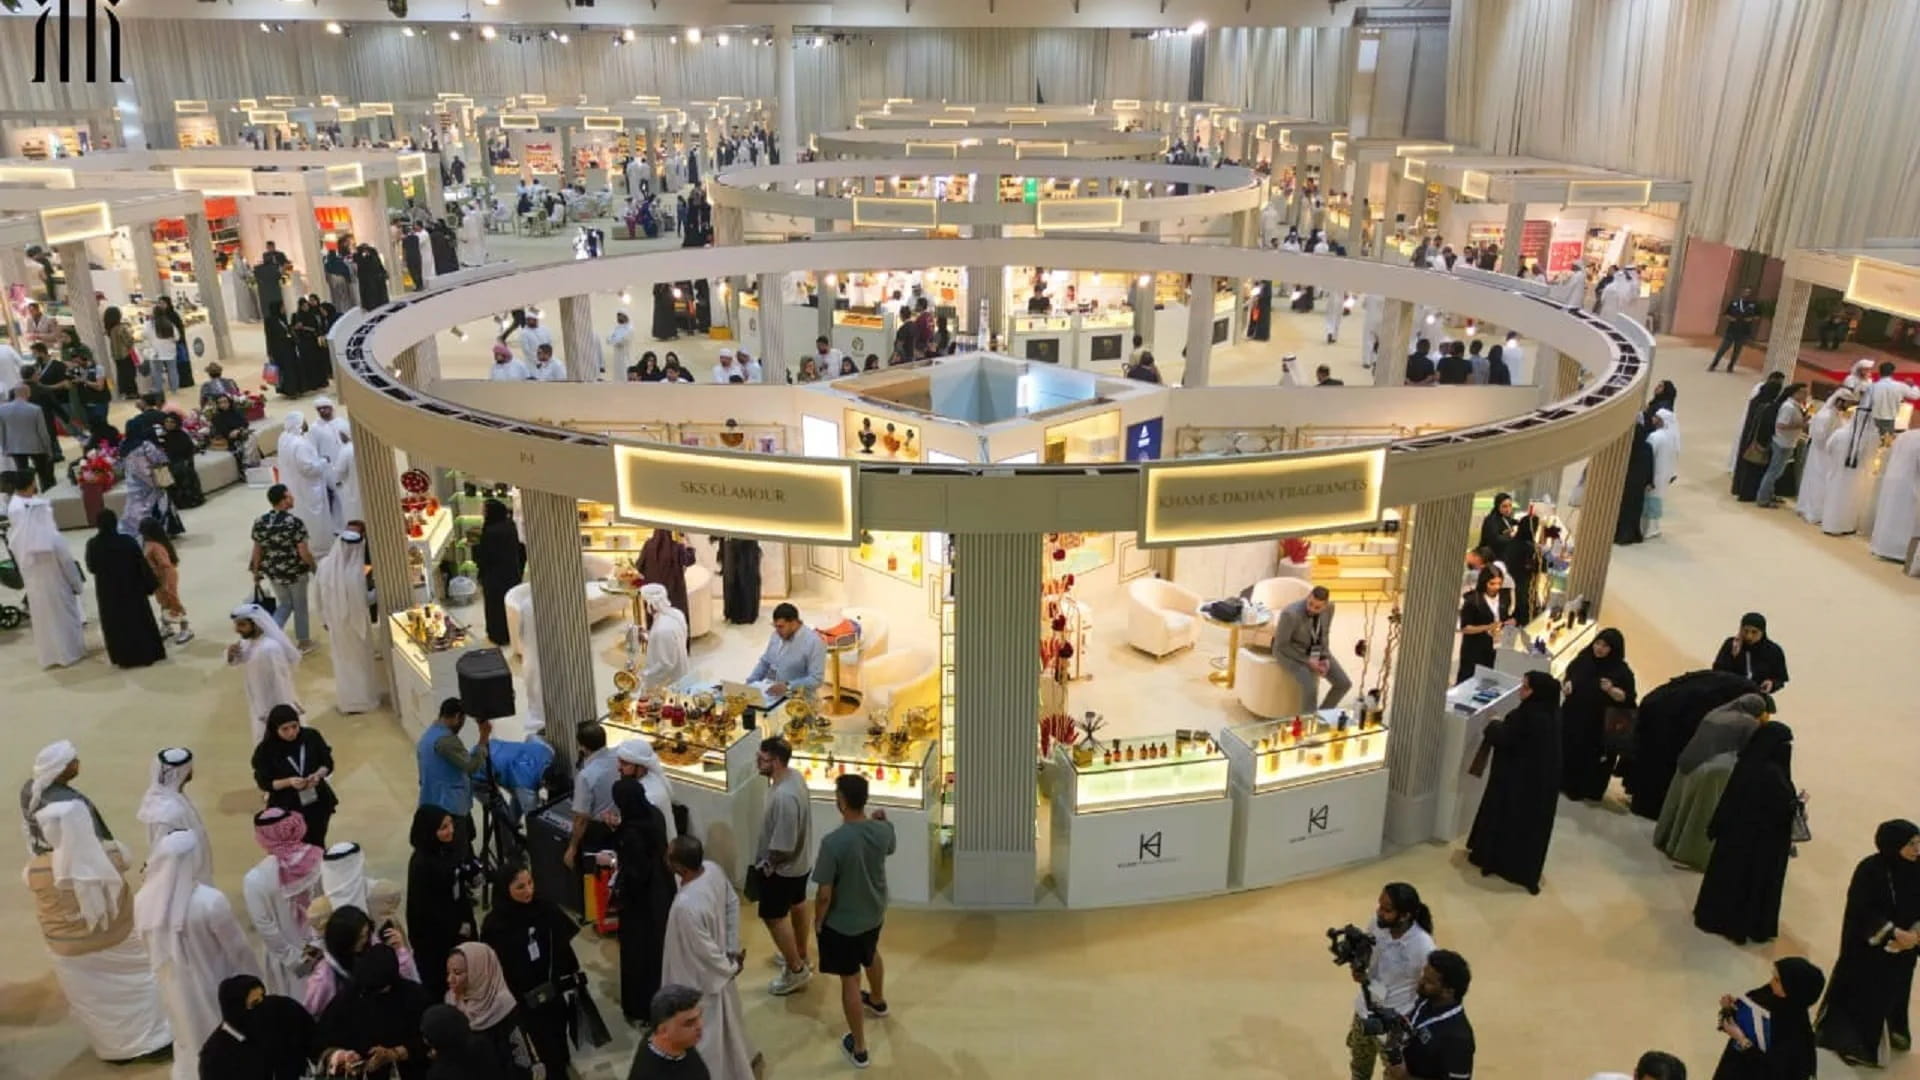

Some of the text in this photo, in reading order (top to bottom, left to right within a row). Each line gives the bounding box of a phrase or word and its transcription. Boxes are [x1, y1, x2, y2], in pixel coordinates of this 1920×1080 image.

[680, 480, 786, 504] SKS GLAMOUR
[1159, 478, 1369, 509] KHAM & DKHAN FRAGRANCES
